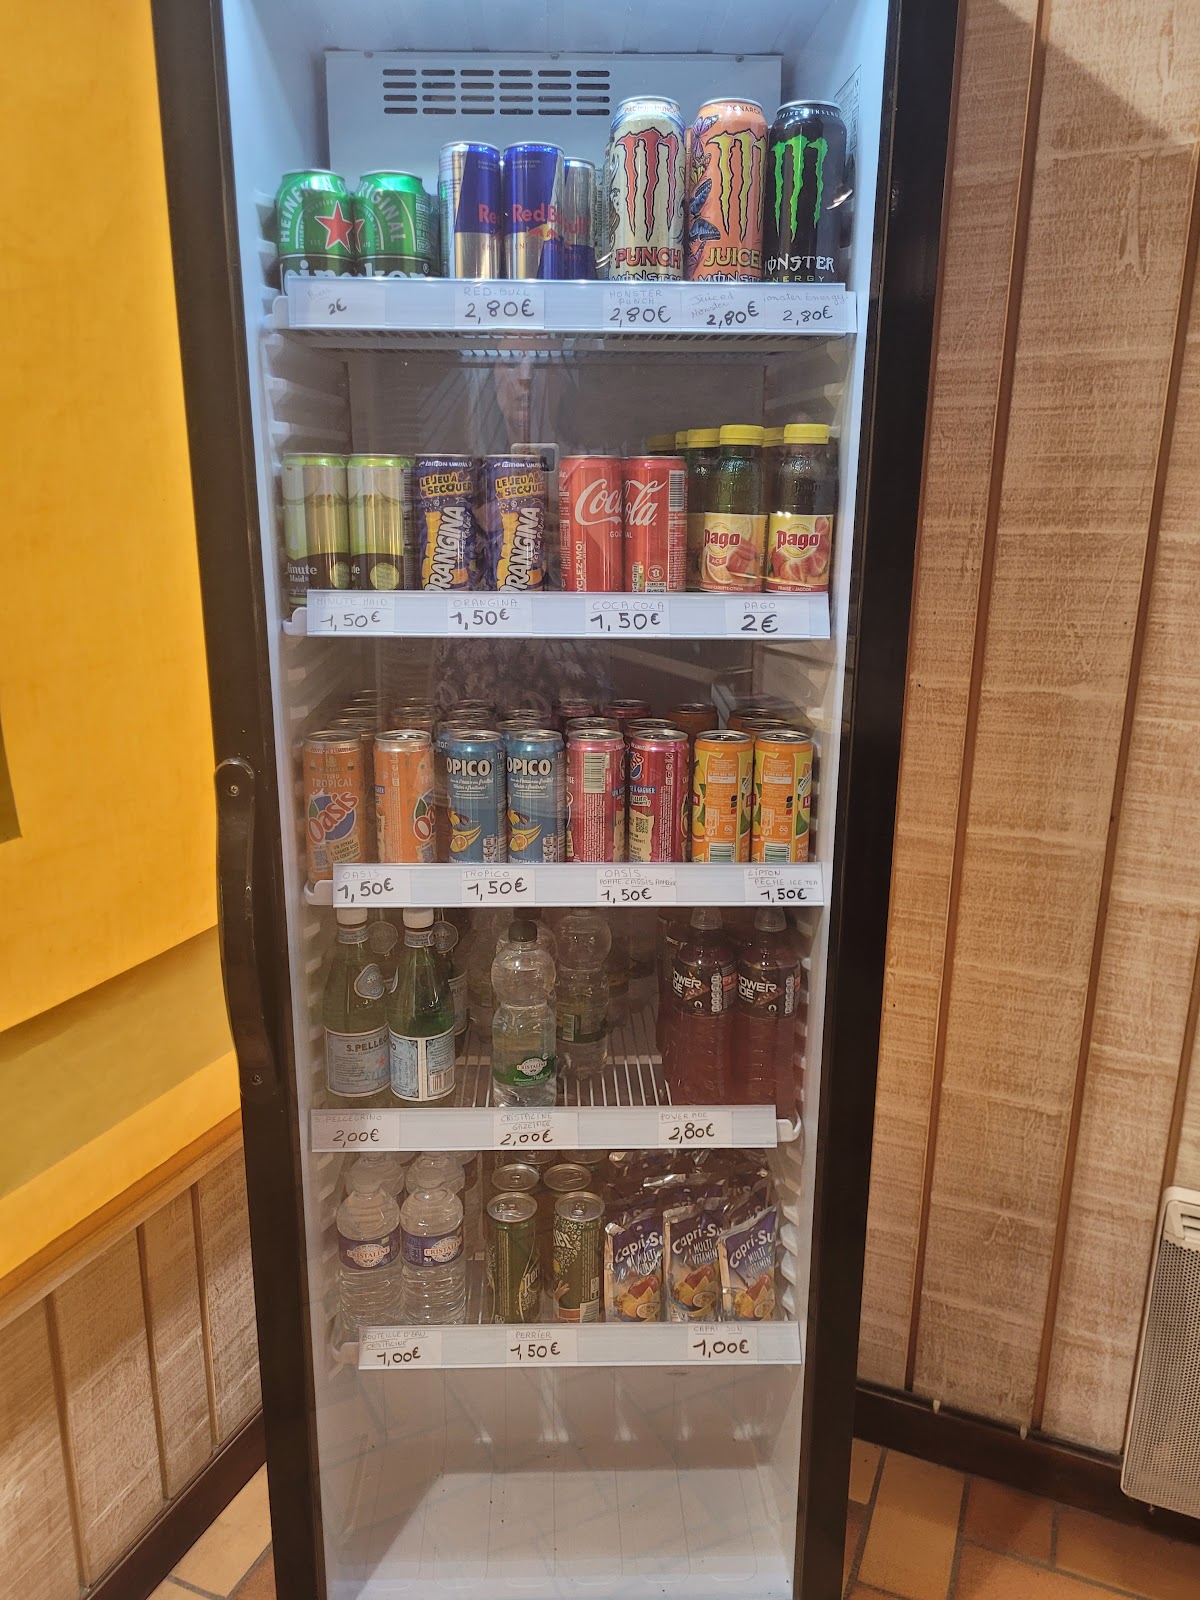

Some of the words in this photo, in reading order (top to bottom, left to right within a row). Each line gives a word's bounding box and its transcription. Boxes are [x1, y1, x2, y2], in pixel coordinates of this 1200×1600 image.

[512, 203, 545, 223] Red
[615, 246, 681, 269] PUNCH
[765, 253, 835, 274] ONSTER
[465, 299, 535, 324] 2,80€
[609, 305, 671, 328] 2,80€
[706, 300, 760, 328] 2,80€
[782, 305, 833, 326] 2,80€
[421, 478, 430, 487] LE
[432, 475, 450, 484] JEU
[427, 482, 472, 495] SECOUER
[497, 479, 507, 488] LE
[510, 476, 527, 486] JEU
[453, 598, 518, 608] ORANGINA
[744, 602, 776, 610] PAGO
[320, 611, 380, 631] 1,50€
[450, 608, 510, 630] 1,50€
[590, 613, 661, 632] 1,50€
[741, 614, 778, 633] 2€
[311, 778, 353, 788] TROPICAL
[308, 791, 359, 844] Oasis
[343, 870, 380, 879] OASIS
[464, 869, 511, 878] TROPICO
[338, 878, 394, 903] 1,50€
[467, 877, 528, 901] 1,50€
[601, 888, 652, 904] 1,50€
[760, 888, 807, 903] 1,50€
[333, 1128, 379, 1147] 2,00€
[500, 1129, 553, 1146] 2,00€
[668, 1122, 715, 1143] 2,80€
[692, 1238, 713, 1254] MULTI
[747, 1246, 765, 1262] MULTI
[516, 1330, 552, 1339] PERRIER
[377, 1346, 421, 1367] 1,00€
[510, 1342, 560, 1360] 1,50€
[693, 1339, 750, 1358] 1,00€
